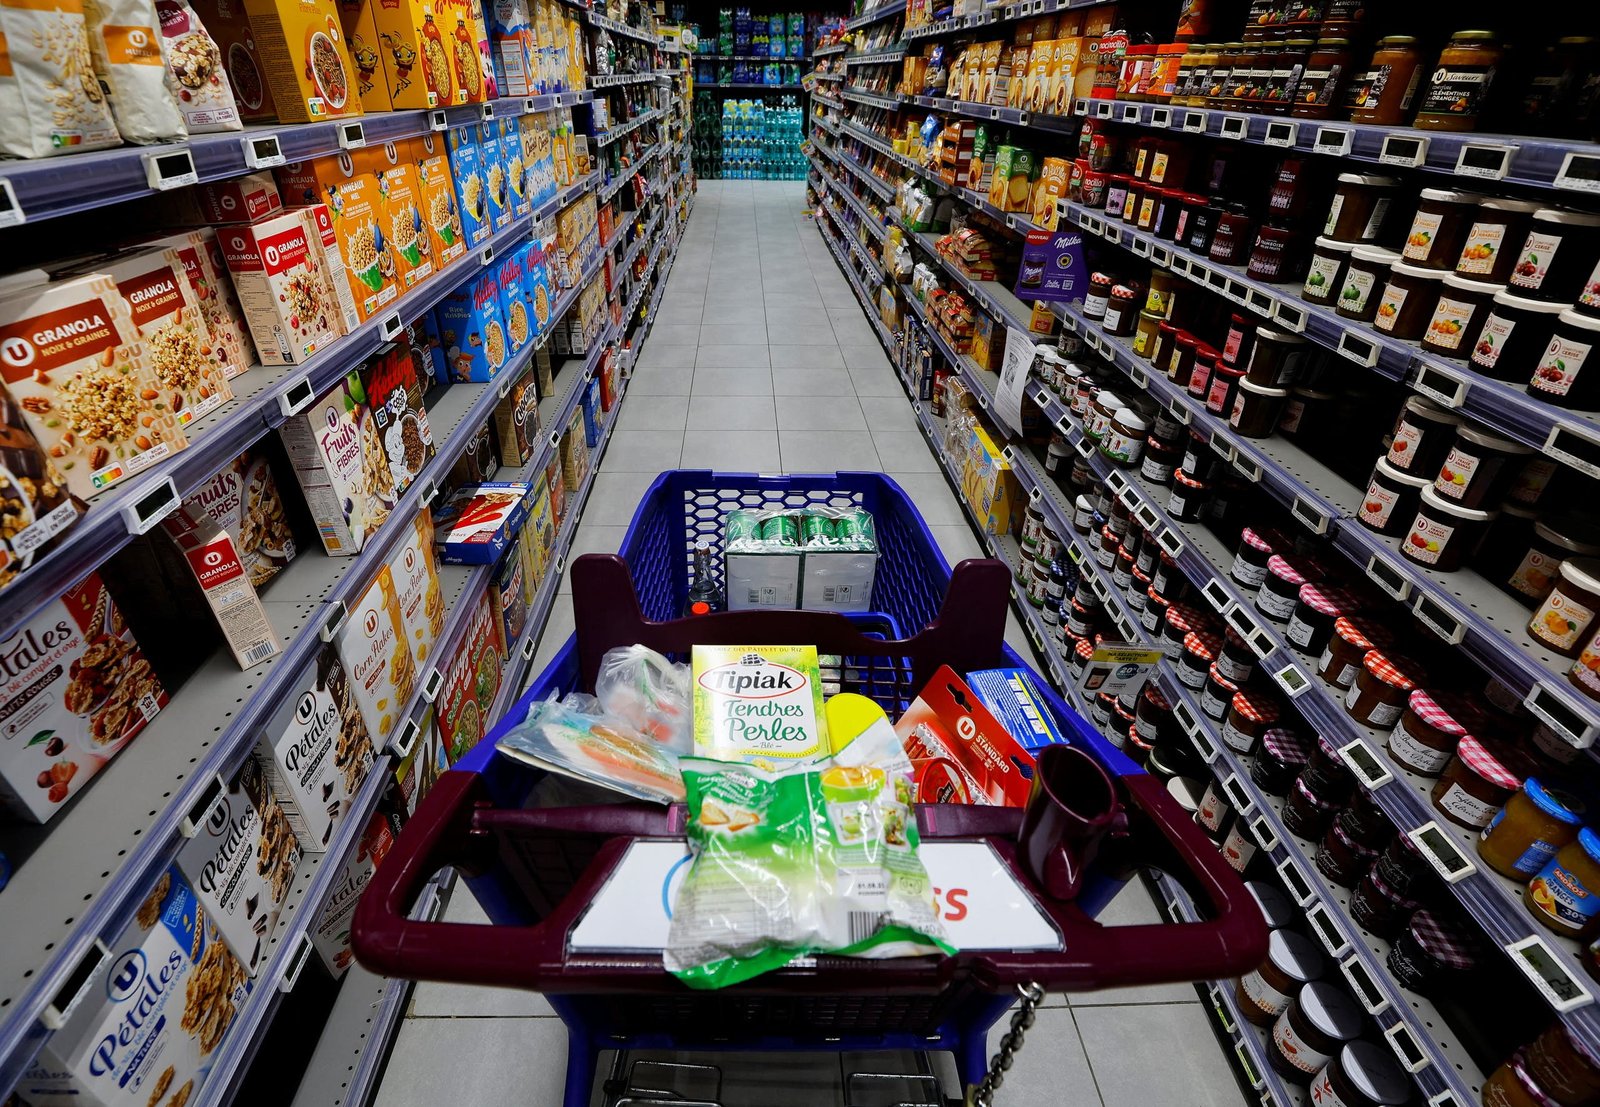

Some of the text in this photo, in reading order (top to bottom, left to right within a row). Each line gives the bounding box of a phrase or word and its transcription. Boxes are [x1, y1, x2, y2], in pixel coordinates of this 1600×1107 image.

[340, 179, 365, 195] ANNEAUX
[278, 237, 305, 254] GRANOLA
[282, 247, 307, 262] FRUITS ROUGES
[1053, 235, 1082, 249] Milka
[1024, 267, 1042, 276] Milka
[129, 279, 175, 304] GRANOLA
[136, 302, 151, 314] NOIX
[155, 292, 179, 307] GRAINES
[32, 314, 105, 346] GRANOLA
[40, 344, 65, 357] NOIX
[74, 328, 111, 346] GRAINES
[321, 423, 356, 464] Fruits
[336, 442, 360, 471] FIBRES
[208, 493, 240, 521] BRES
[200, 560, 238, 580] GRANOLA
[203, 566, 240, 584] FRUITS ROUGES
[399, 564, 427, 610] Corn Flakes
[22, 657, 54, 683] complet
[62, 637, 80, 654] orge
[353, 625, 394, 681] Corn Flakes
[26, 669, 58, 698] ROUGES
[712, 670, 793, 694] Tipiak
[724, 699, 804, 717] Tendres
[285, 703, 336, 772] Pétales
[724, 717, 808, 742] Perles
[760, 741, 775, 749] Blé
[975, 734, 1010, 774] STANDARD
[210, 802, 226, 829] U
[200, 804, 255, 893] Pétales
[233, 837, 249, 866] complet
[1545, 878, 1576, 905] ORANGES
[1554, 869, 1585, 897] ANDROS
[89, 950, 182, 1077] Pétales
[133, 1031, 146, 1048] blé
[145, 991, 170, 1028] complet
[175, 961, 188, 984] orge
[127, 1029, 158, 1076] NATURE
